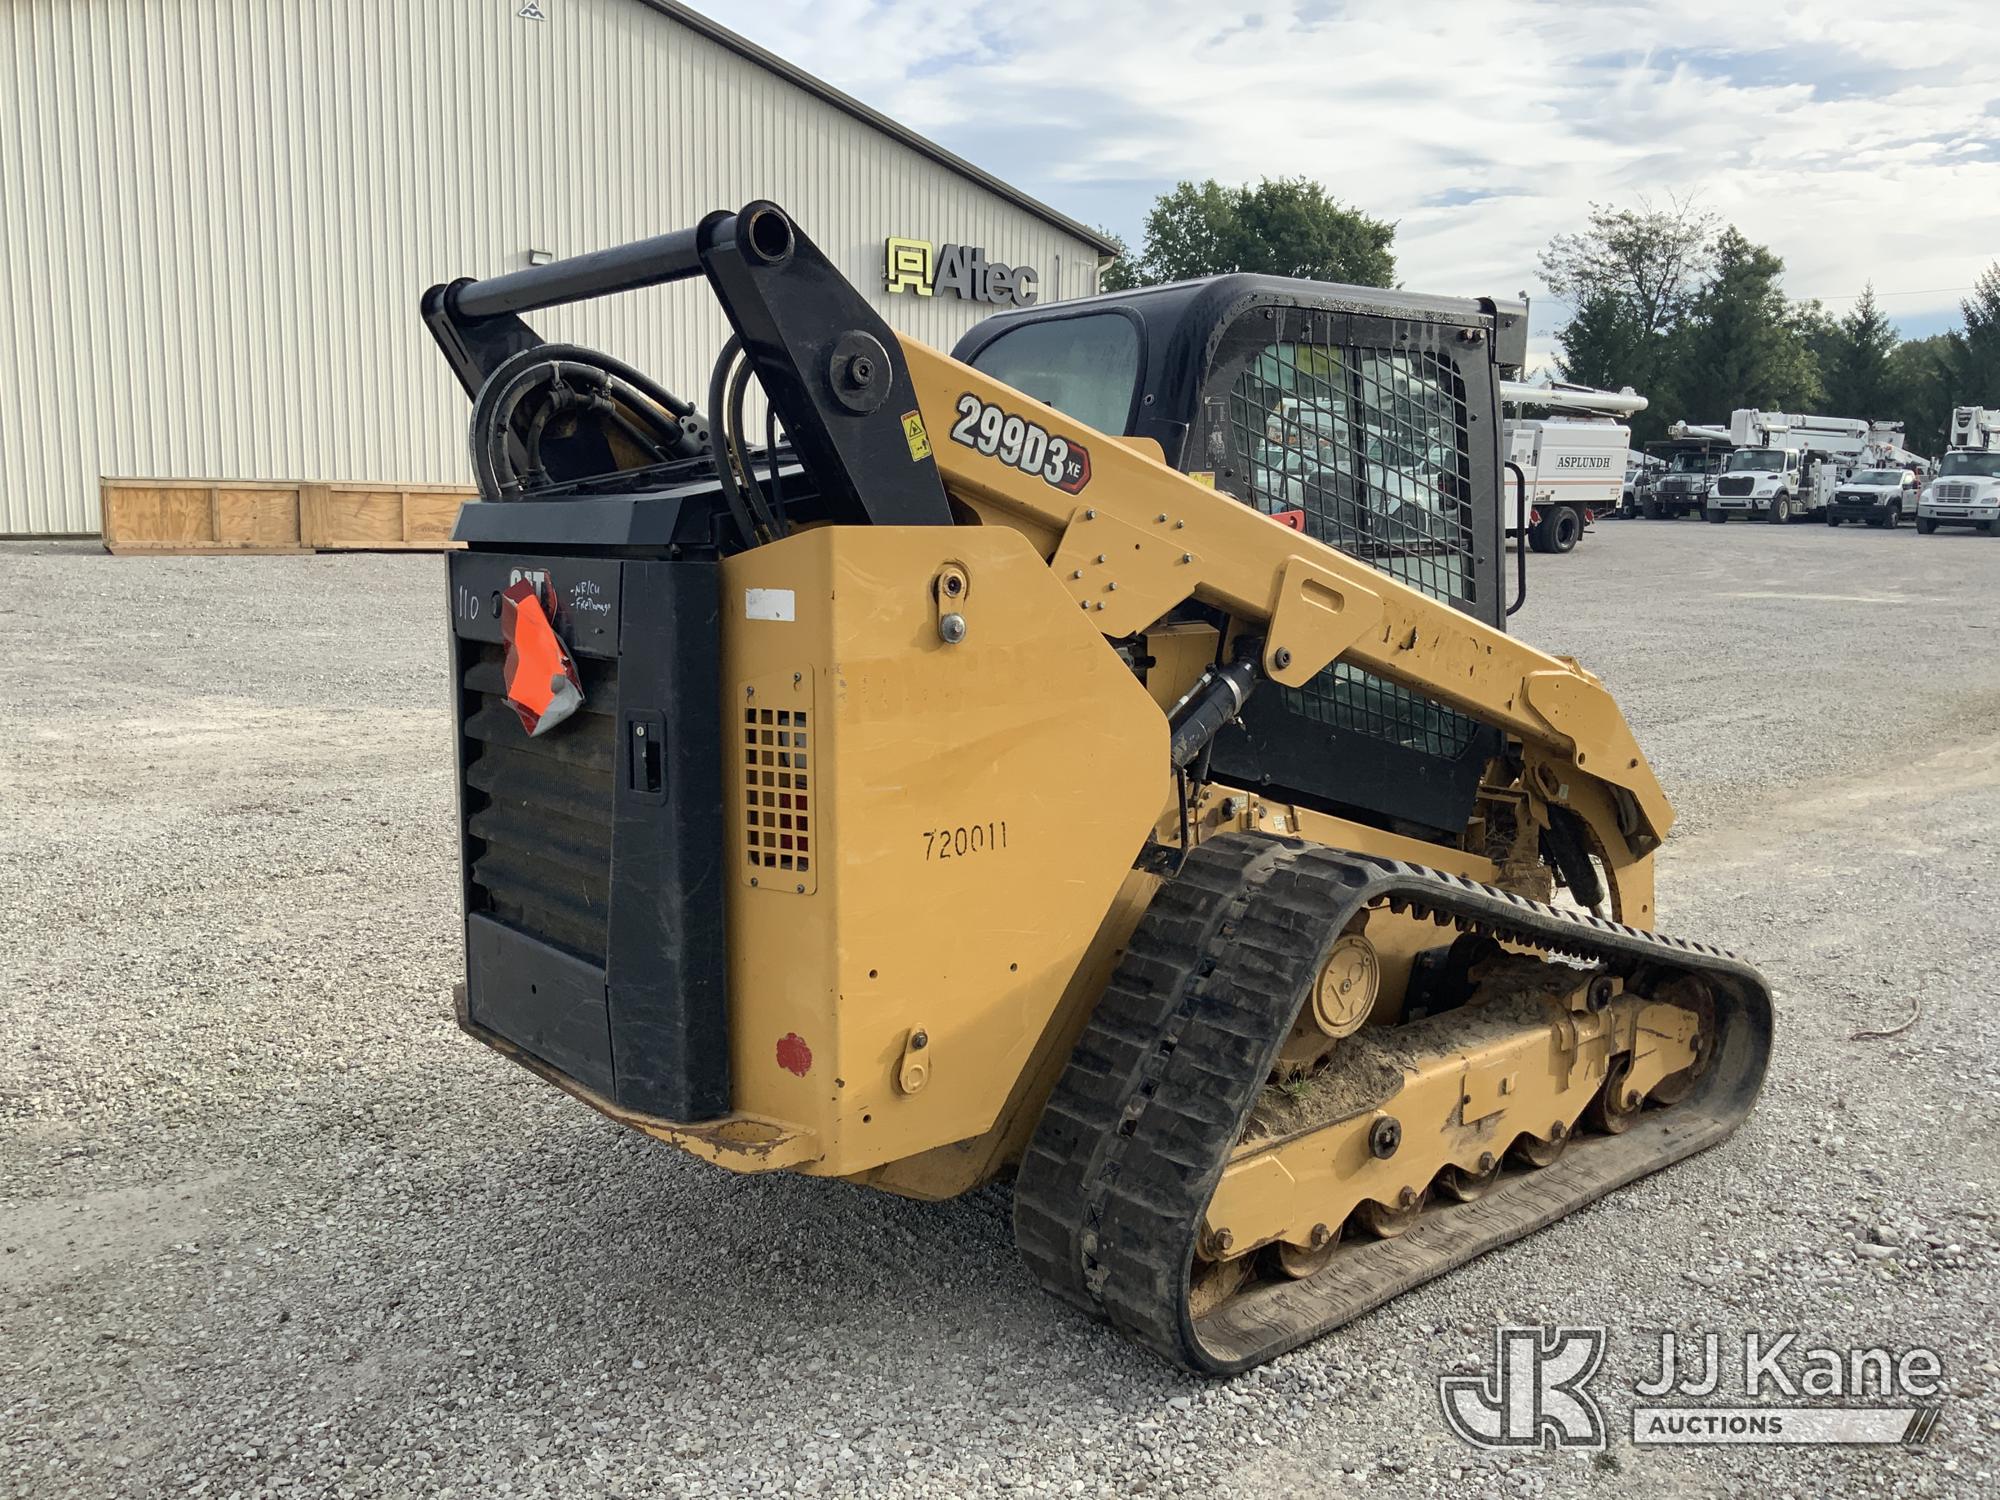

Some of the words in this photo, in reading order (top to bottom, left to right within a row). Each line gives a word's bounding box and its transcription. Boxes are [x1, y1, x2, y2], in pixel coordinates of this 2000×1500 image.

[932, 243, 1039, 307] Altec
[951, 395, 1068, 484] 299D3
[1066, 459, 1082, 478] XE
[1557, 456, 1611, 468] ASPLUNDH
[923, 821, 1006, 861] 720011
